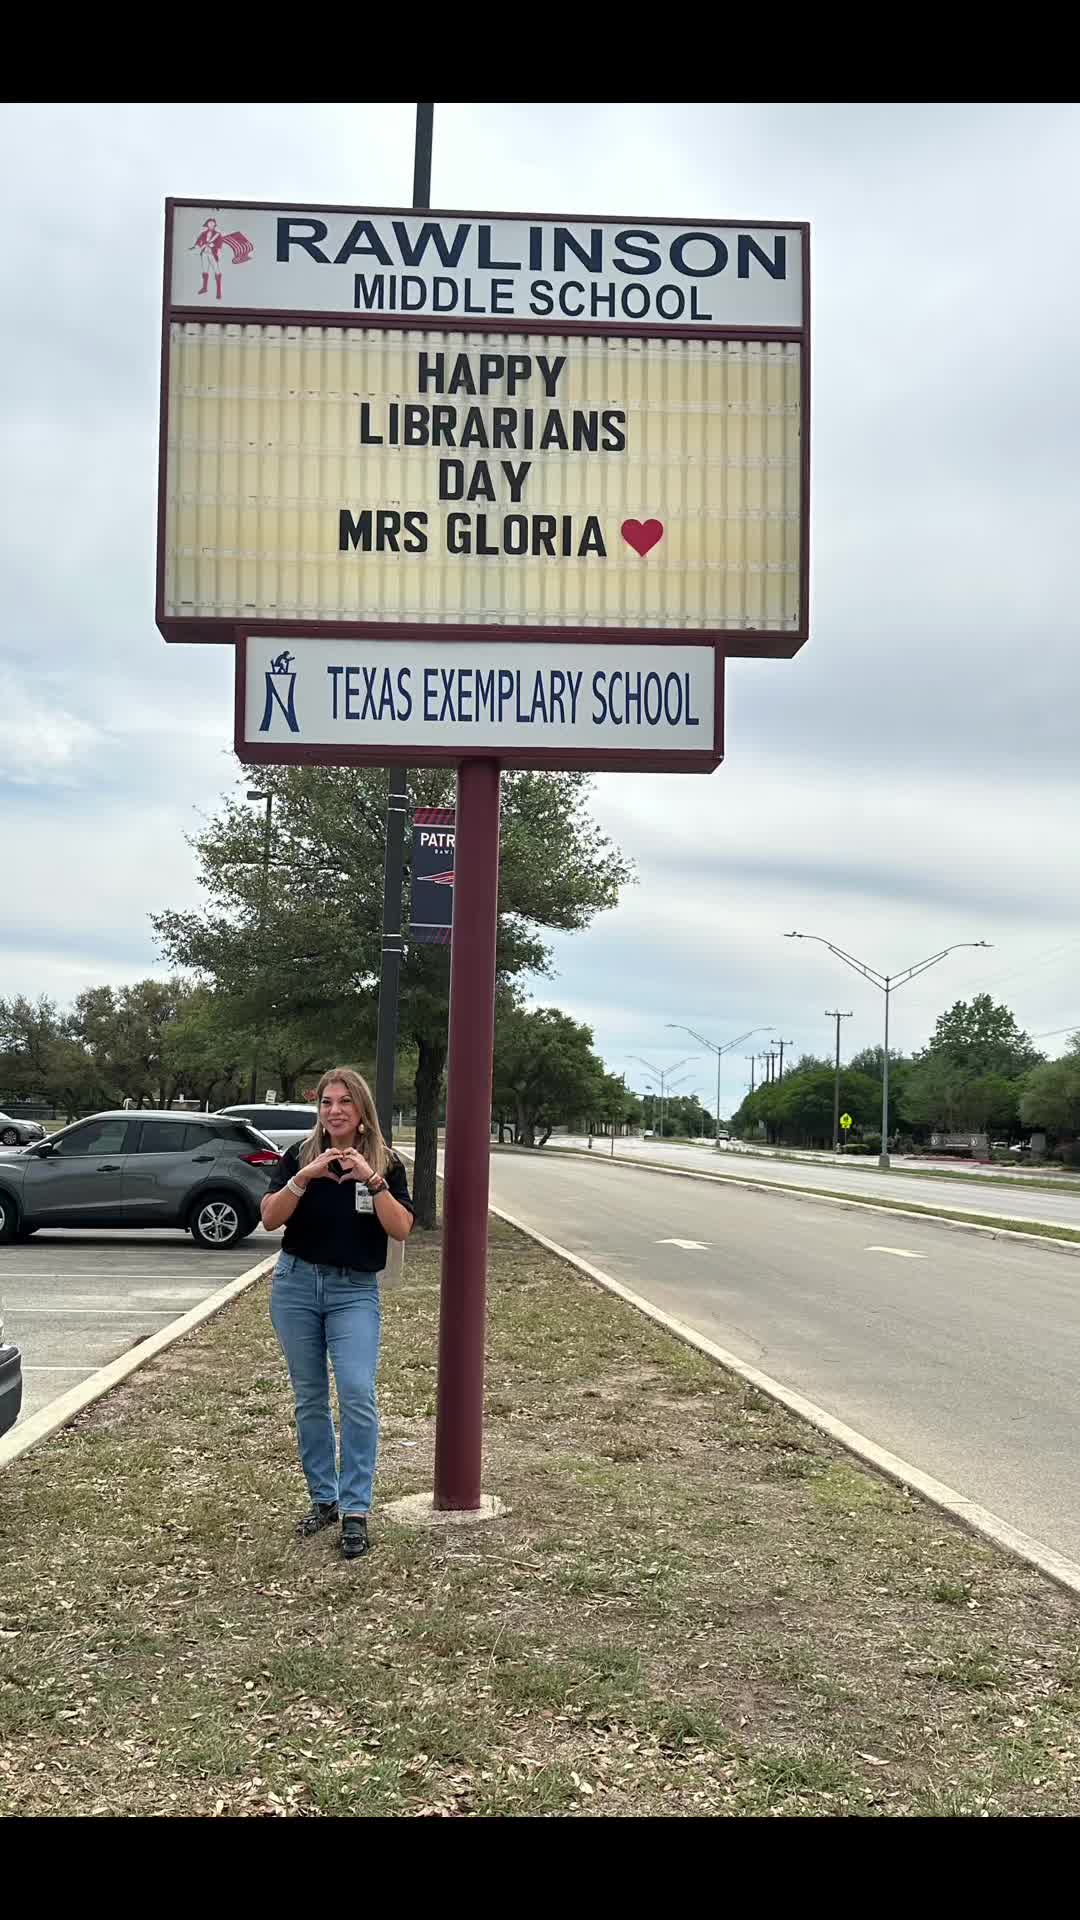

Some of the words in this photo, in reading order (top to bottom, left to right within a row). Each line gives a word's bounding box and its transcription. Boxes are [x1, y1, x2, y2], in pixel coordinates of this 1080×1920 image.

[276, 217, 787, 281] RAWLINSON
[353, 273, 515, 315] MIDDLE
[529, 279, 713, 321] SCHOOL
[418, 351, 567, 398] HAPPY
[360, 402, 626, 452] LIBRARIANS
[438, 458, 532, 503] DAY
[338, 509, 429, 553] MRS
[446, 512, 607, 557] GLORIA
[326, 665, 413, 721] TEXAS
[423, 668, 583, 725] EXEMPLARY
[592, 670, 700, 726] SCHOOL
